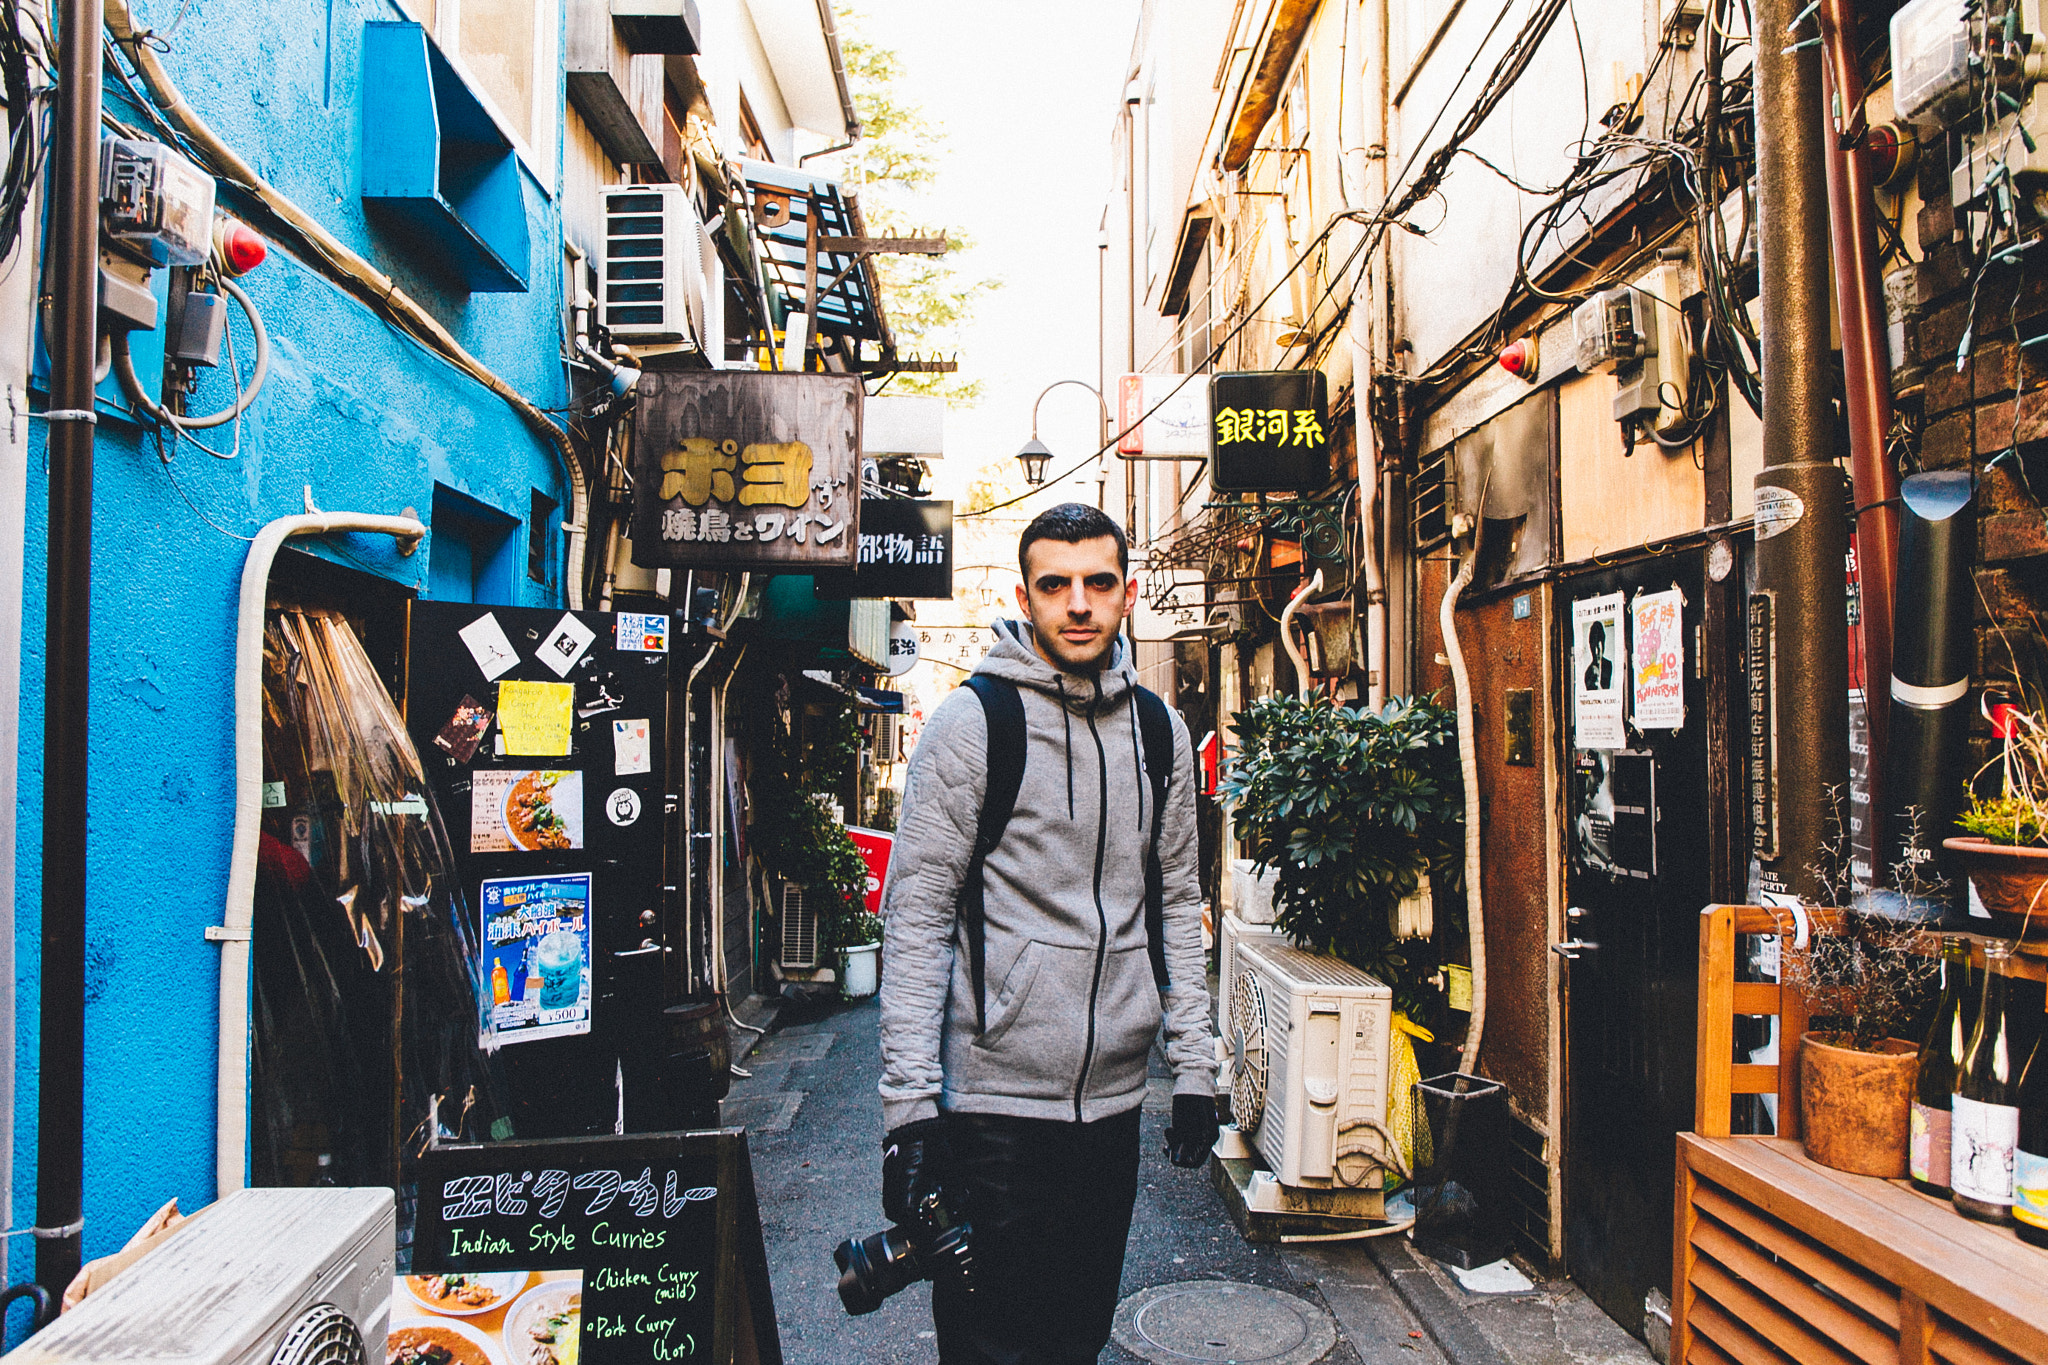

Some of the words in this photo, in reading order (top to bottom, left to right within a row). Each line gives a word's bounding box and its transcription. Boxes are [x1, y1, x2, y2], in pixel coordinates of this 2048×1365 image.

[1215, 406, 1326, 449] 銀河系
[659, 437, 814, 508] ポヨ
[662, 508, 845, 545] 焼鳥とワイン
[1660, 652, 1676, 680] 10
[266, 784, 279, 805] 入口
[548, 1008, 577, 1021] ¥500
[443, 1166, 718, 1221] エピタフカレー
[448, 1228, 515, 1257] Indian
[529, 1223, 576, 1254] Style
[591, 1221, 667, 1249] Curries
[596, 1267, 651, 1291] Chicken
[657, 1262, 699, 1287] Curry
[654, 1283, 696, 1305] (mild)
[597, 1314, 627, 1339] Pork
[635, 1314, 676, 1339] Curry
[653, 1333, 695, 1361] (hot)
